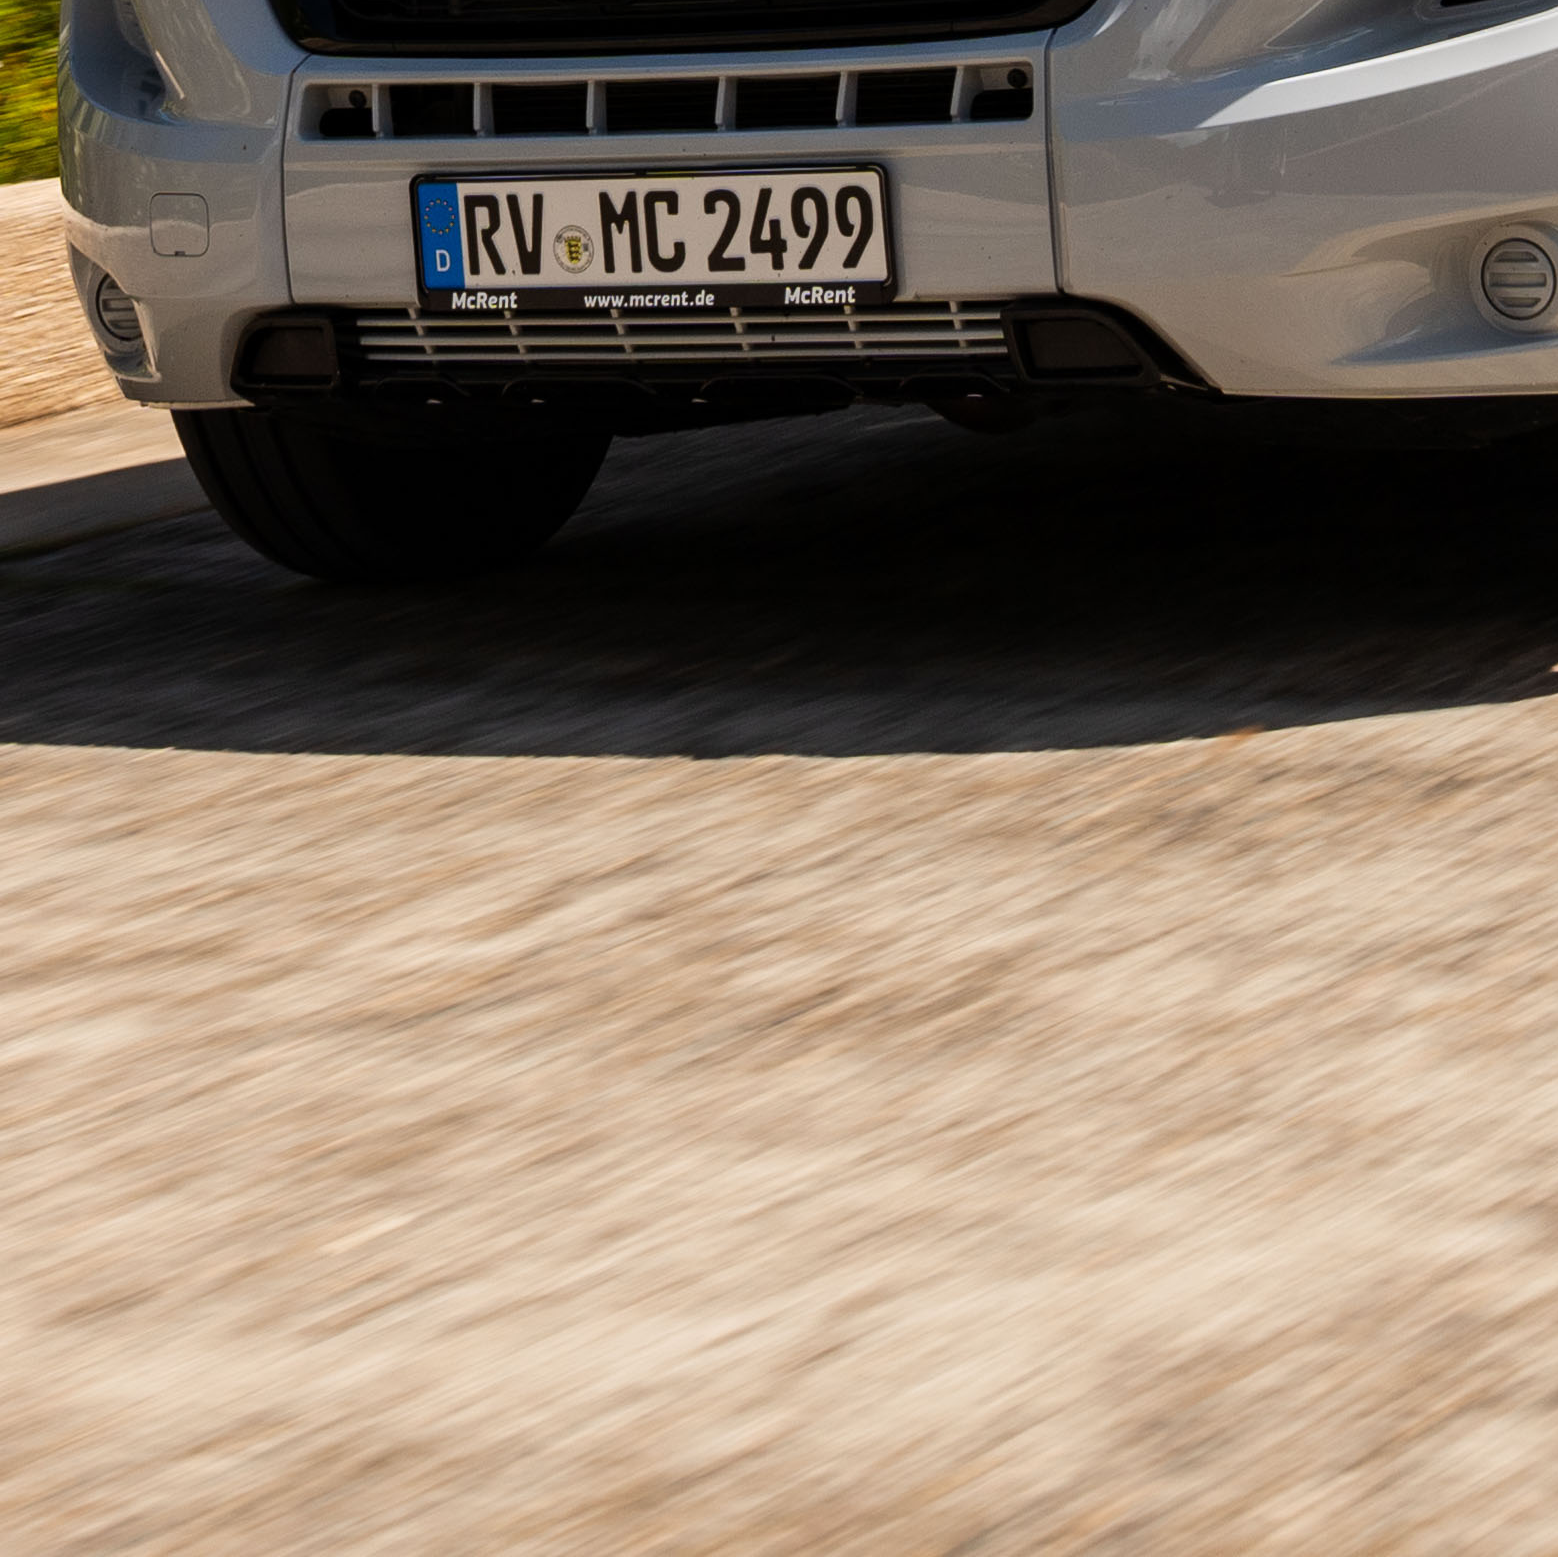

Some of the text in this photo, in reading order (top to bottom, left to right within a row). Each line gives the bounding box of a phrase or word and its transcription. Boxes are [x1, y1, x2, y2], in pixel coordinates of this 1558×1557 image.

[463, 193, 543, 275] RV
[599, 190, 686, 273] MC
[703, 185, 874, 272] 2499
[436, 249, 450, 272] D
[451, 286, 856, 310] McRent www.mcrent.de McRent
